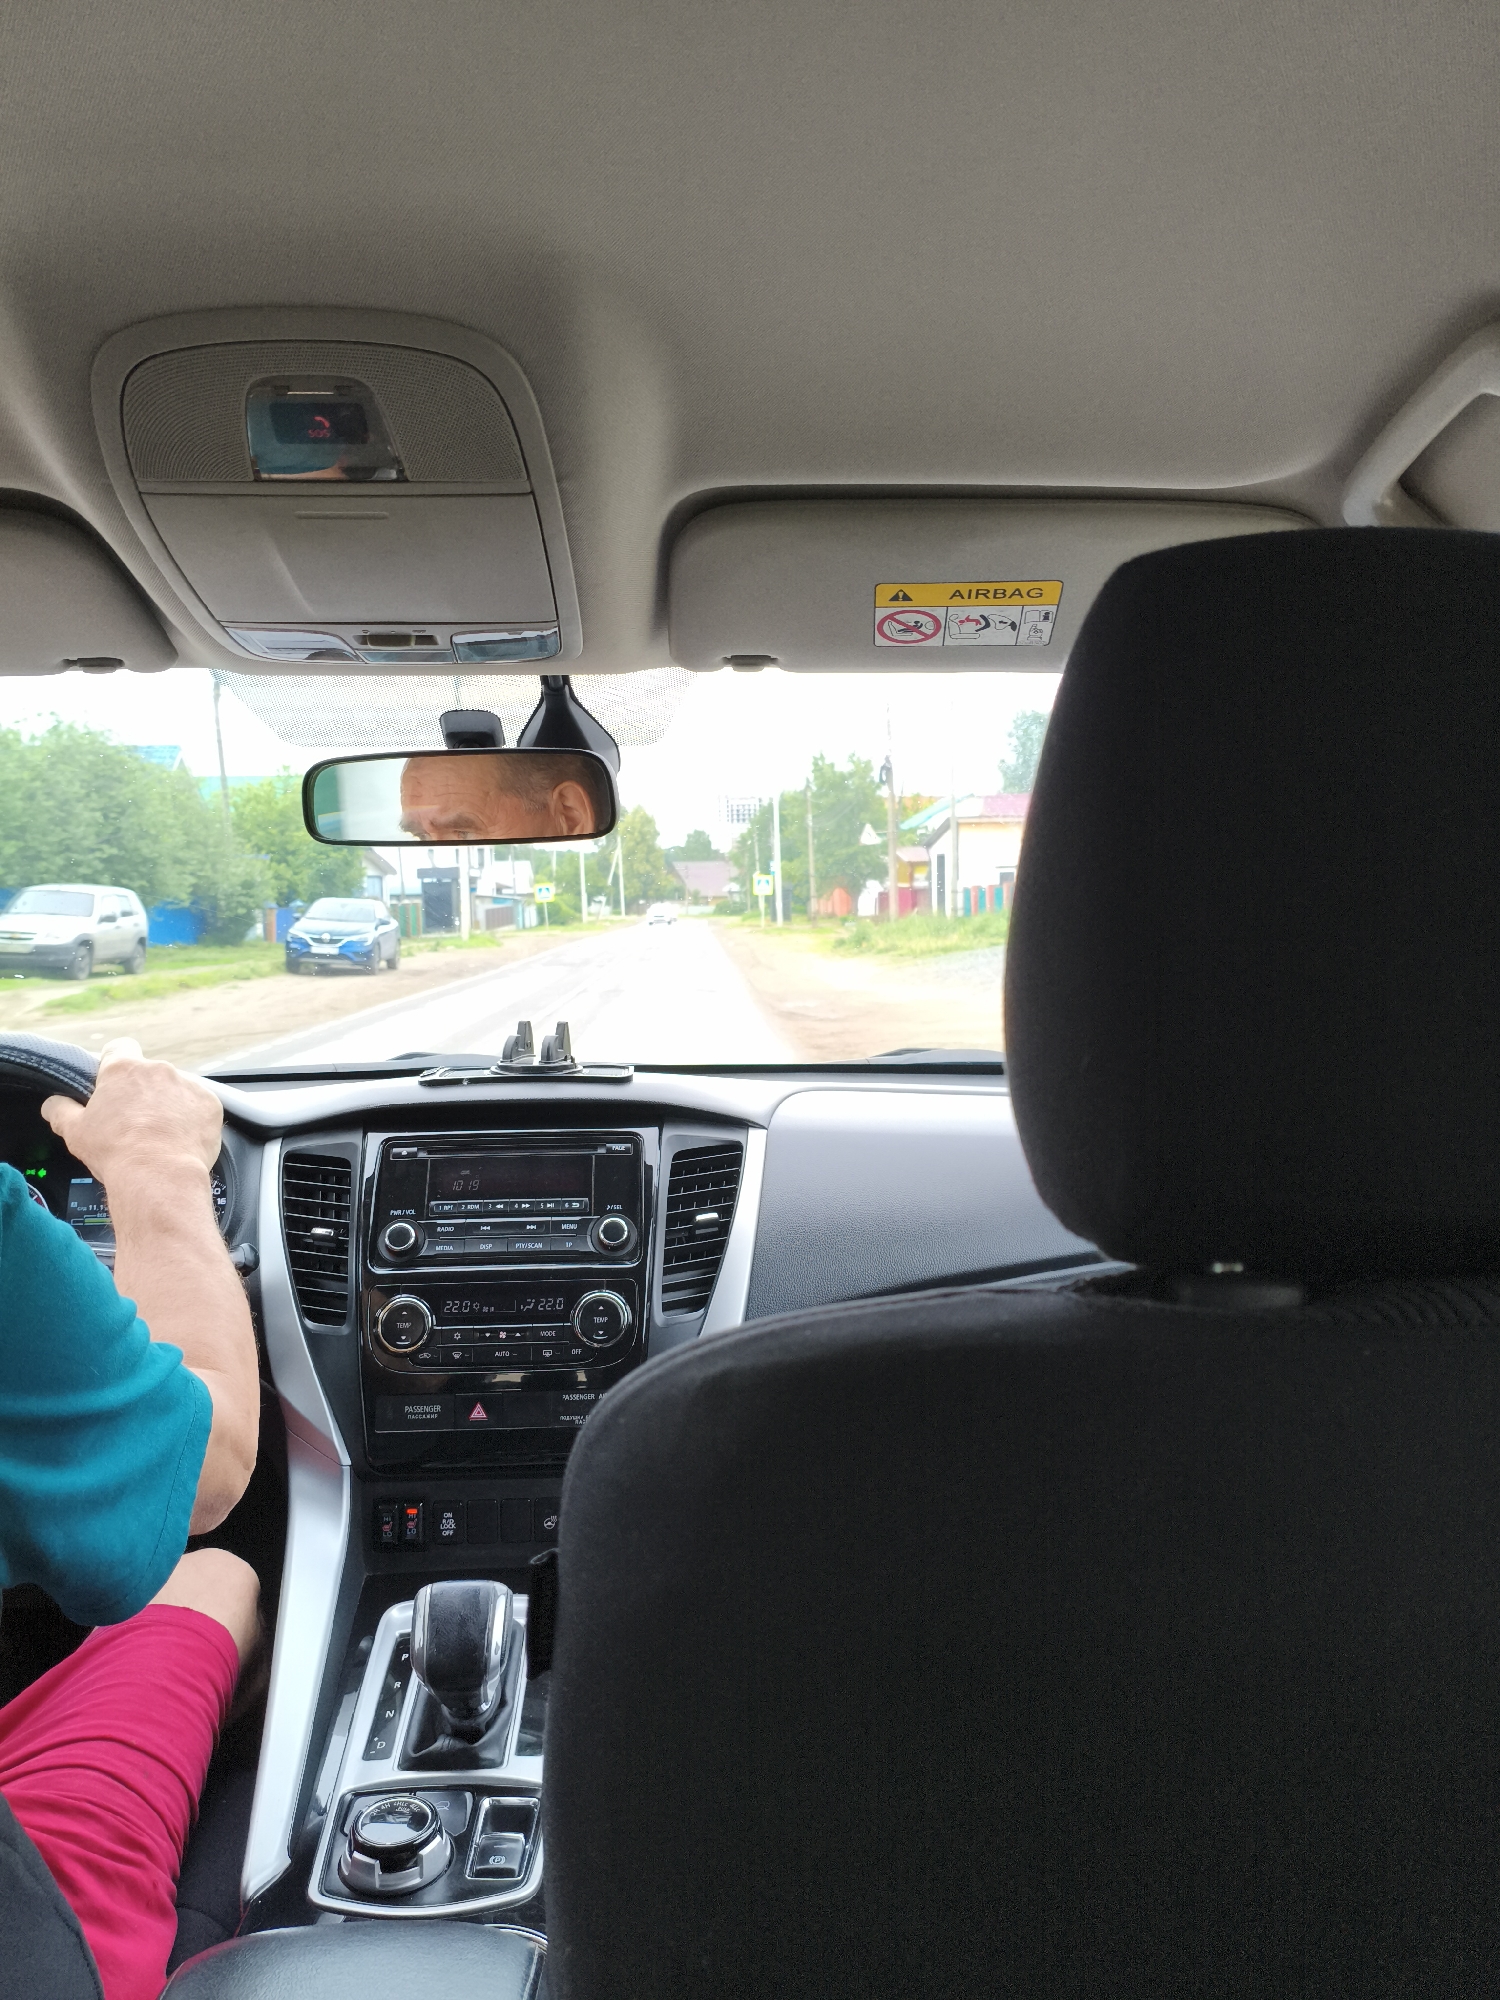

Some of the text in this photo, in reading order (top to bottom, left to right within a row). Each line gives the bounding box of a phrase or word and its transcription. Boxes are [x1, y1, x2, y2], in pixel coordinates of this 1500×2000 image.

[308, 429, 330, 438] SOS
[948, 587, 1043, 600] AIRBAG
[443, 1300, 471, 1313] 22.0
[537, 1297, 564, 1310] 22.0
[562, 1393, 596, 1401] PASSENGER
[404, 1404, 442, 1413] PASSENGER
[401, 1653, 409, 1661] P
[393, 1680, 402, 1689] R
[385, 1709, 395, 1718] N
[376, 1740, 386, 1749] D
[381, 1802, 391, 1810] 4H
